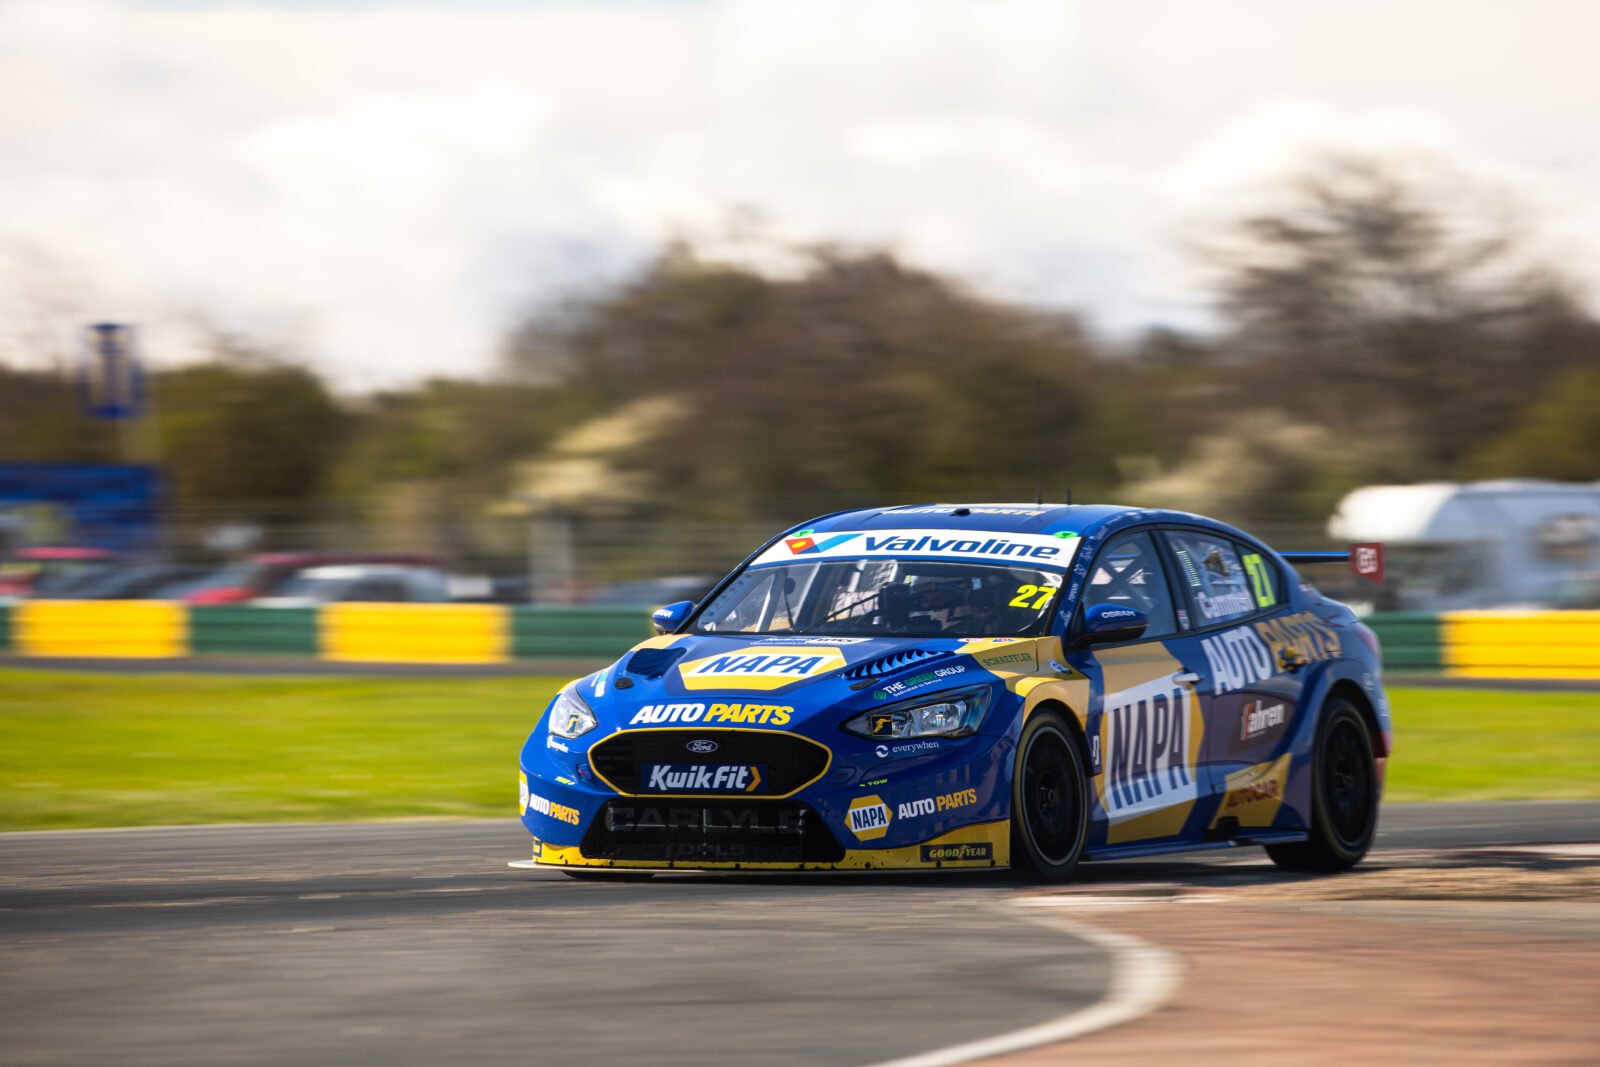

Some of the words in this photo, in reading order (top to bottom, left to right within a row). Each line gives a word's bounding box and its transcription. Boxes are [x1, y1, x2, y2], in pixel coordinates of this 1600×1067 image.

[866, 535, 1060, 560] Valvoline
[1009, 584, 1057, 611] 27
[1100, 609, 1138, 619] OSRAM
[710, 655, 825, 676] NAPA
[982, 653, 1033, 667] SCHAEFFLER
[1200, 625, 1272, 696] AUTO
[882, 681, 907, 695] THE
[905, 672, 937, 687] GREEN
[934, 665, 966, 678] GROUP
[629, 702, 706, 725] AUTO
[703, 703, 794, 726] PARTS
[692, 741, 713, 751] Ford
[892, 740, 940, 754] everywhen
[1110, 686, 1192, 810] NAPA
[867, 778, 888, 787] TOW
[529, 793, 550, 815] AUTO
[549, 801, 581, 826] PARTS
[897, 797, 936, 821] AUTO
[936, 787, 977, 812] PARTS
[852, 804, 887, 831] NAPA
